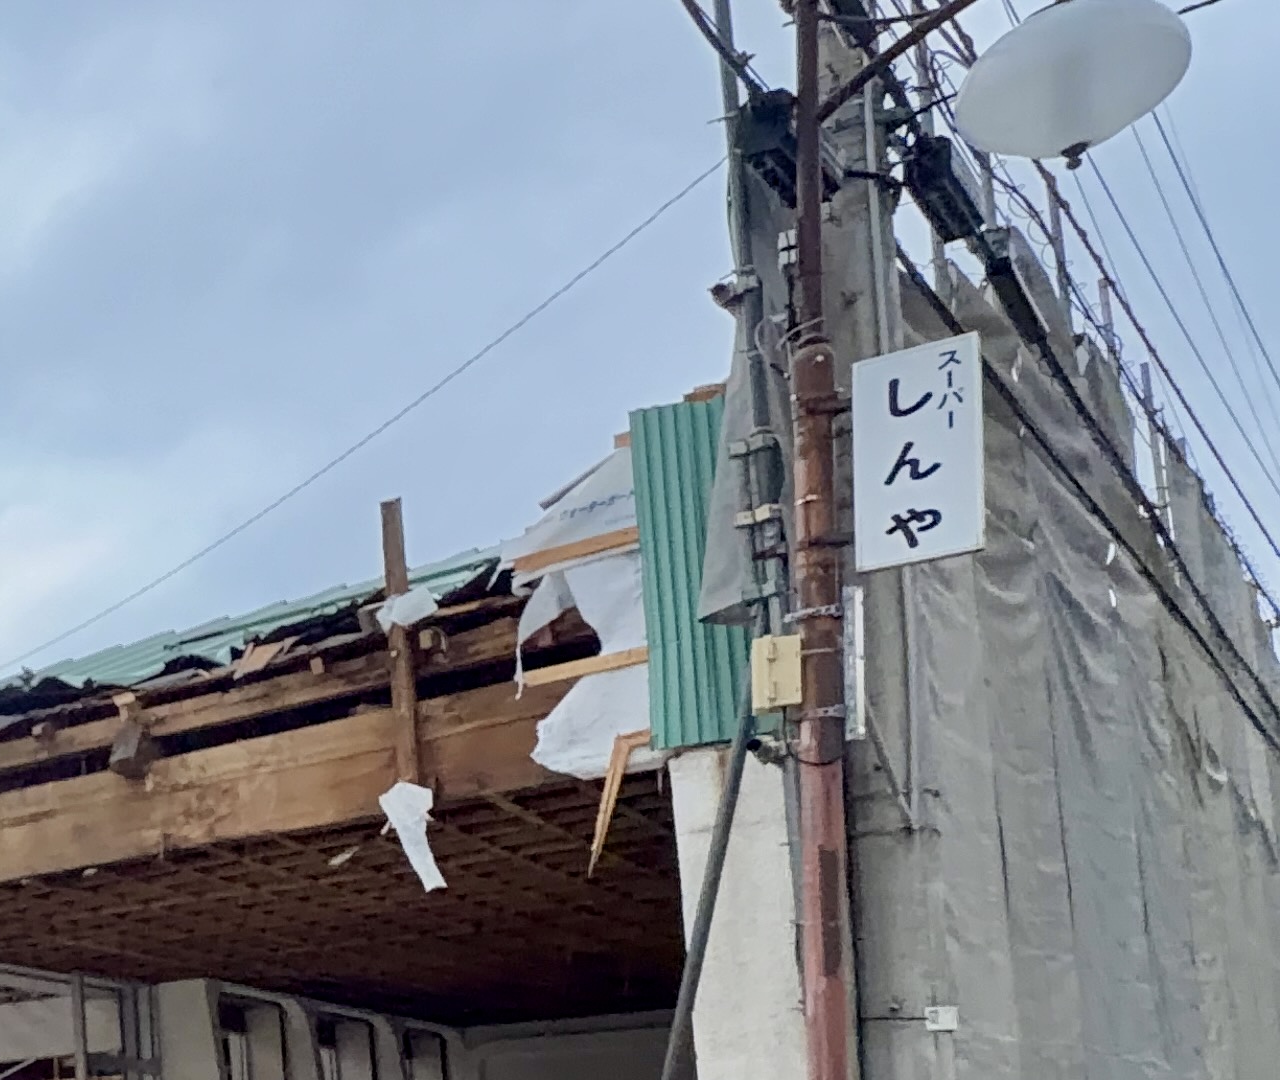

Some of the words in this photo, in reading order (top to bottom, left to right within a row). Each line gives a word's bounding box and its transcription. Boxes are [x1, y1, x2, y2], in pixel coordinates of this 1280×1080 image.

[937, 350, 964, 429] スーパー
[884, 378, 943, 548] しんや
